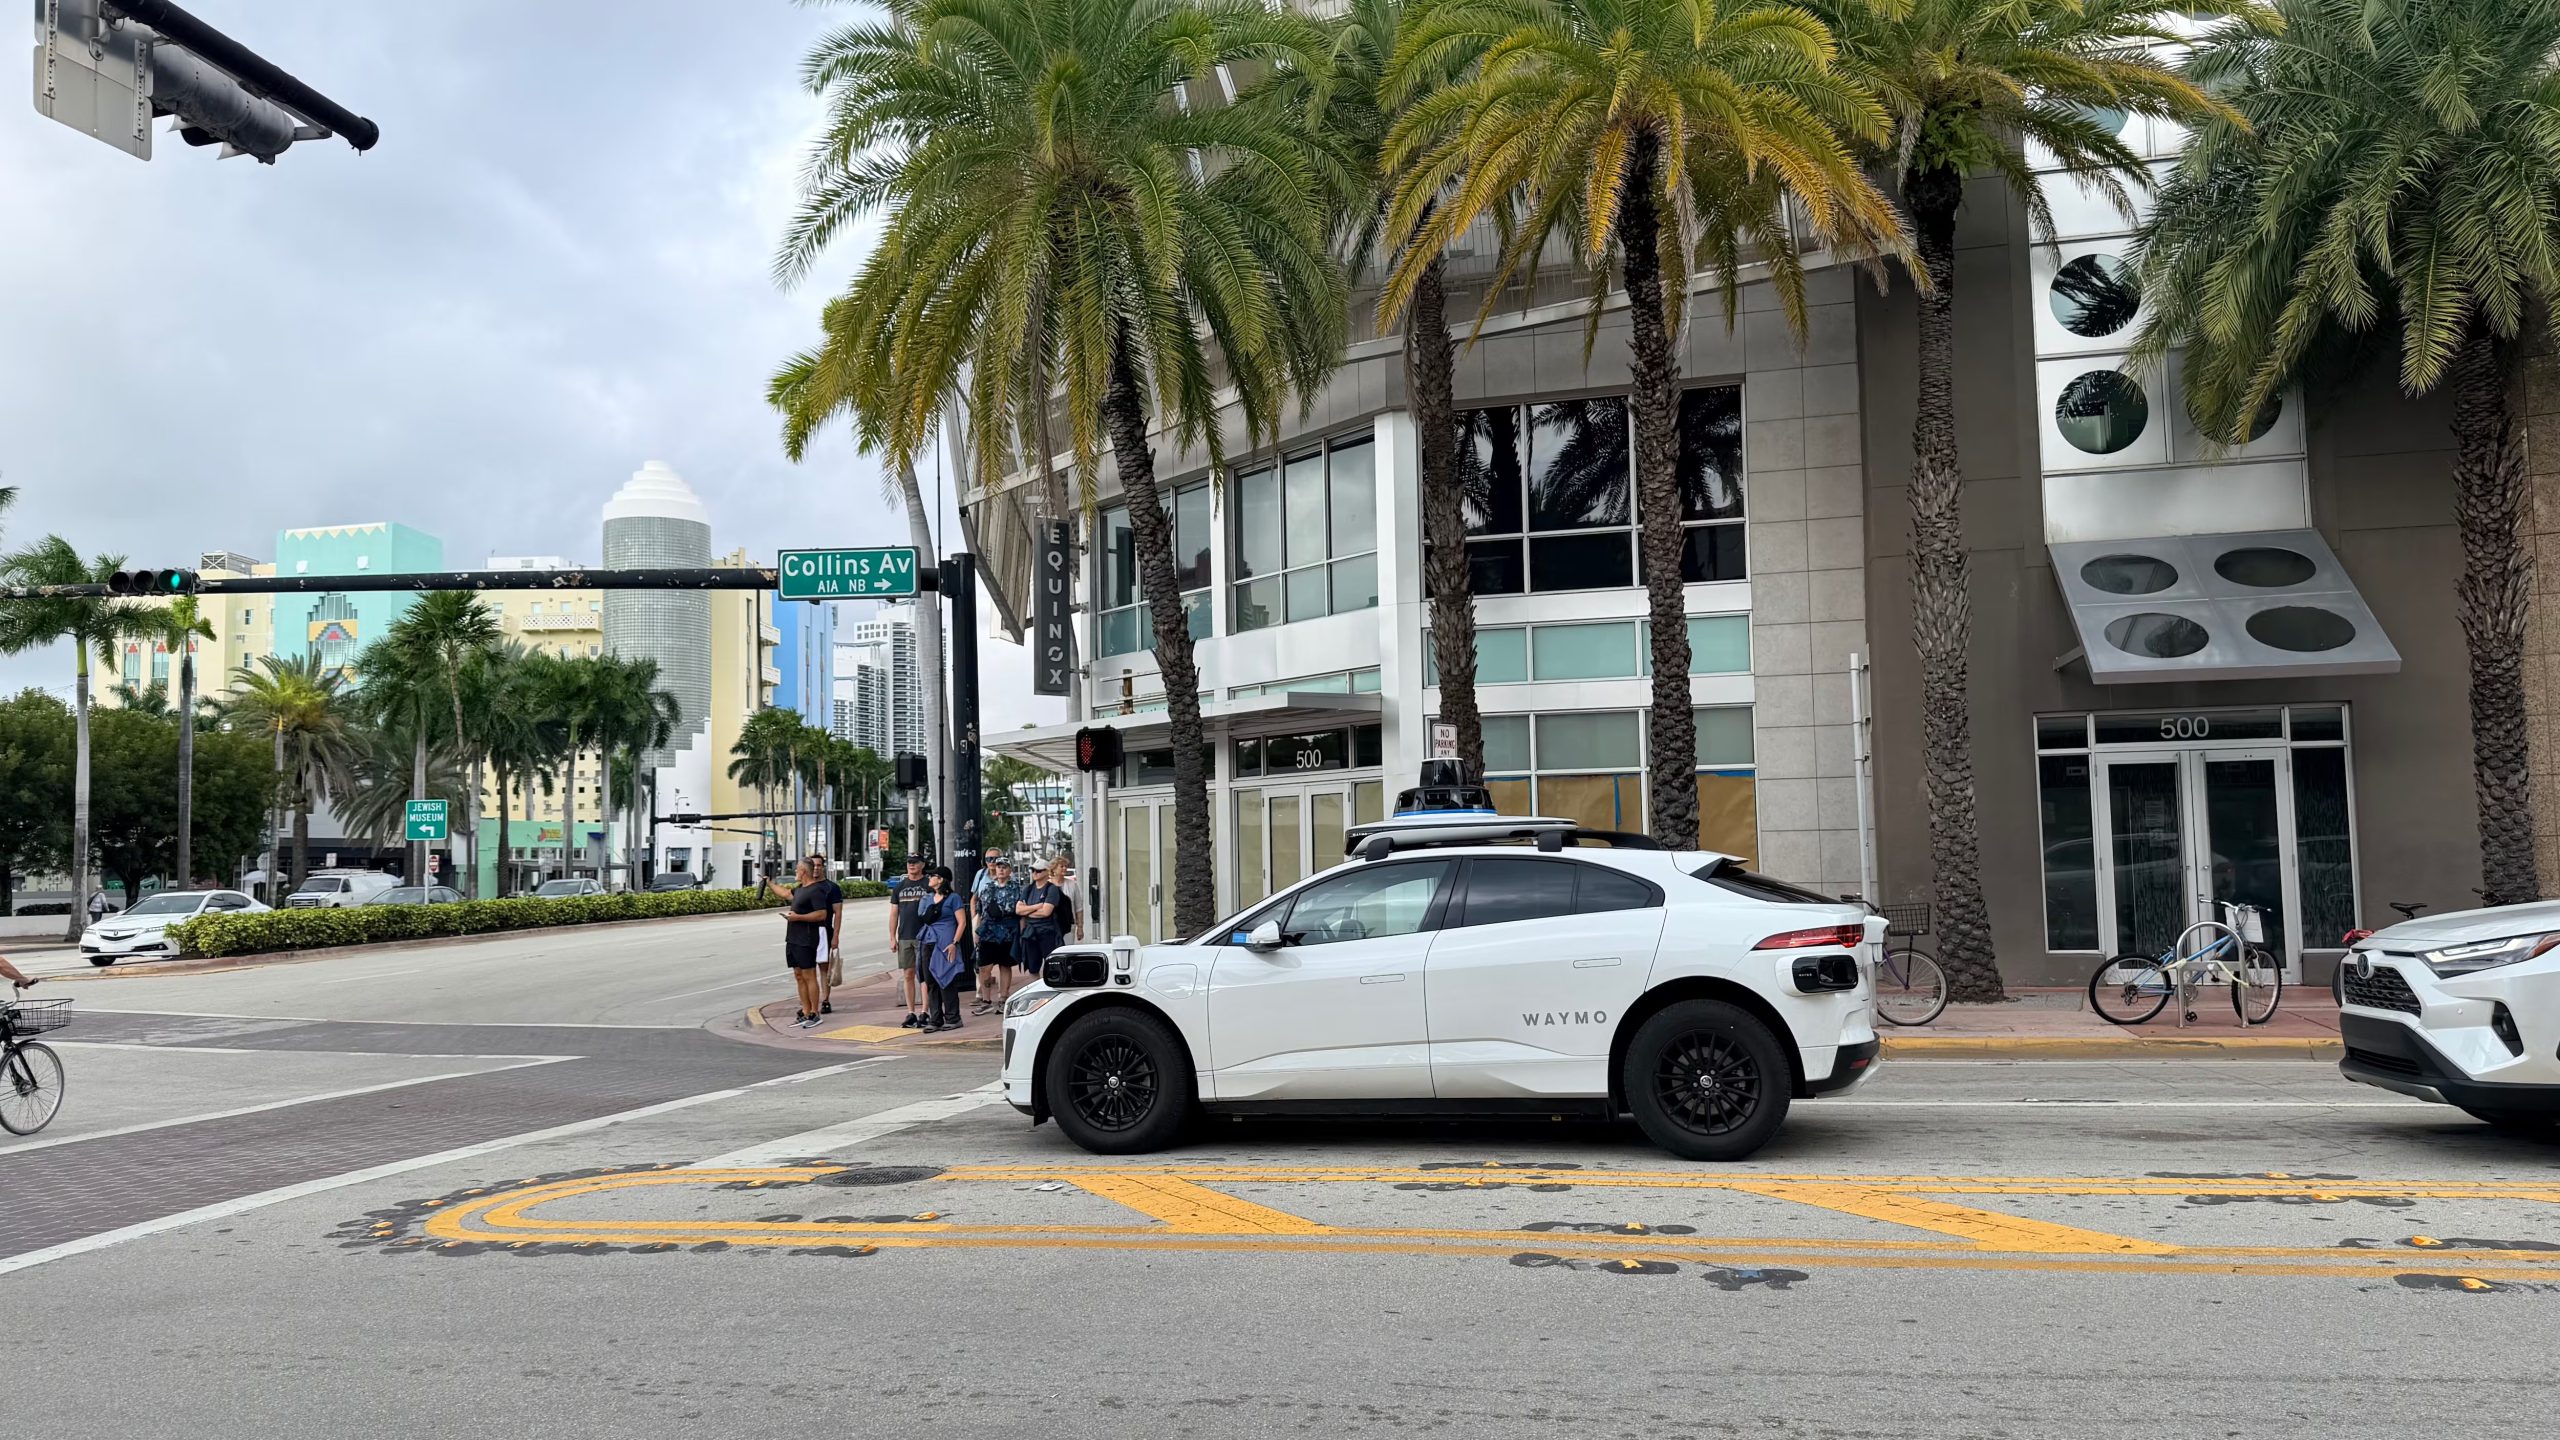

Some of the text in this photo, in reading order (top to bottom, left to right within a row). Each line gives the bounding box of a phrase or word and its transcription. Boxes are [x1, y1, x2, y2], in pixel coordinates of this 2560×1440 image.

[784, 552, 912, 577] Collins Av
[817, 579, 866, 593] A1A NB
[1047, 528, 1064, 685] EQUINOX
[1440, 728, 1450, 739] NO
[2160, 716, 2210, 739] 500
[1434, 739, 1455, 750] PARKING
[1296, 749, 1322, 769] 500
[412, 802, 442, 812] JEWISH
[409, 813, 444, 822] MUSEUM
[1522, 1010, 1607, 1027] WAYMO
